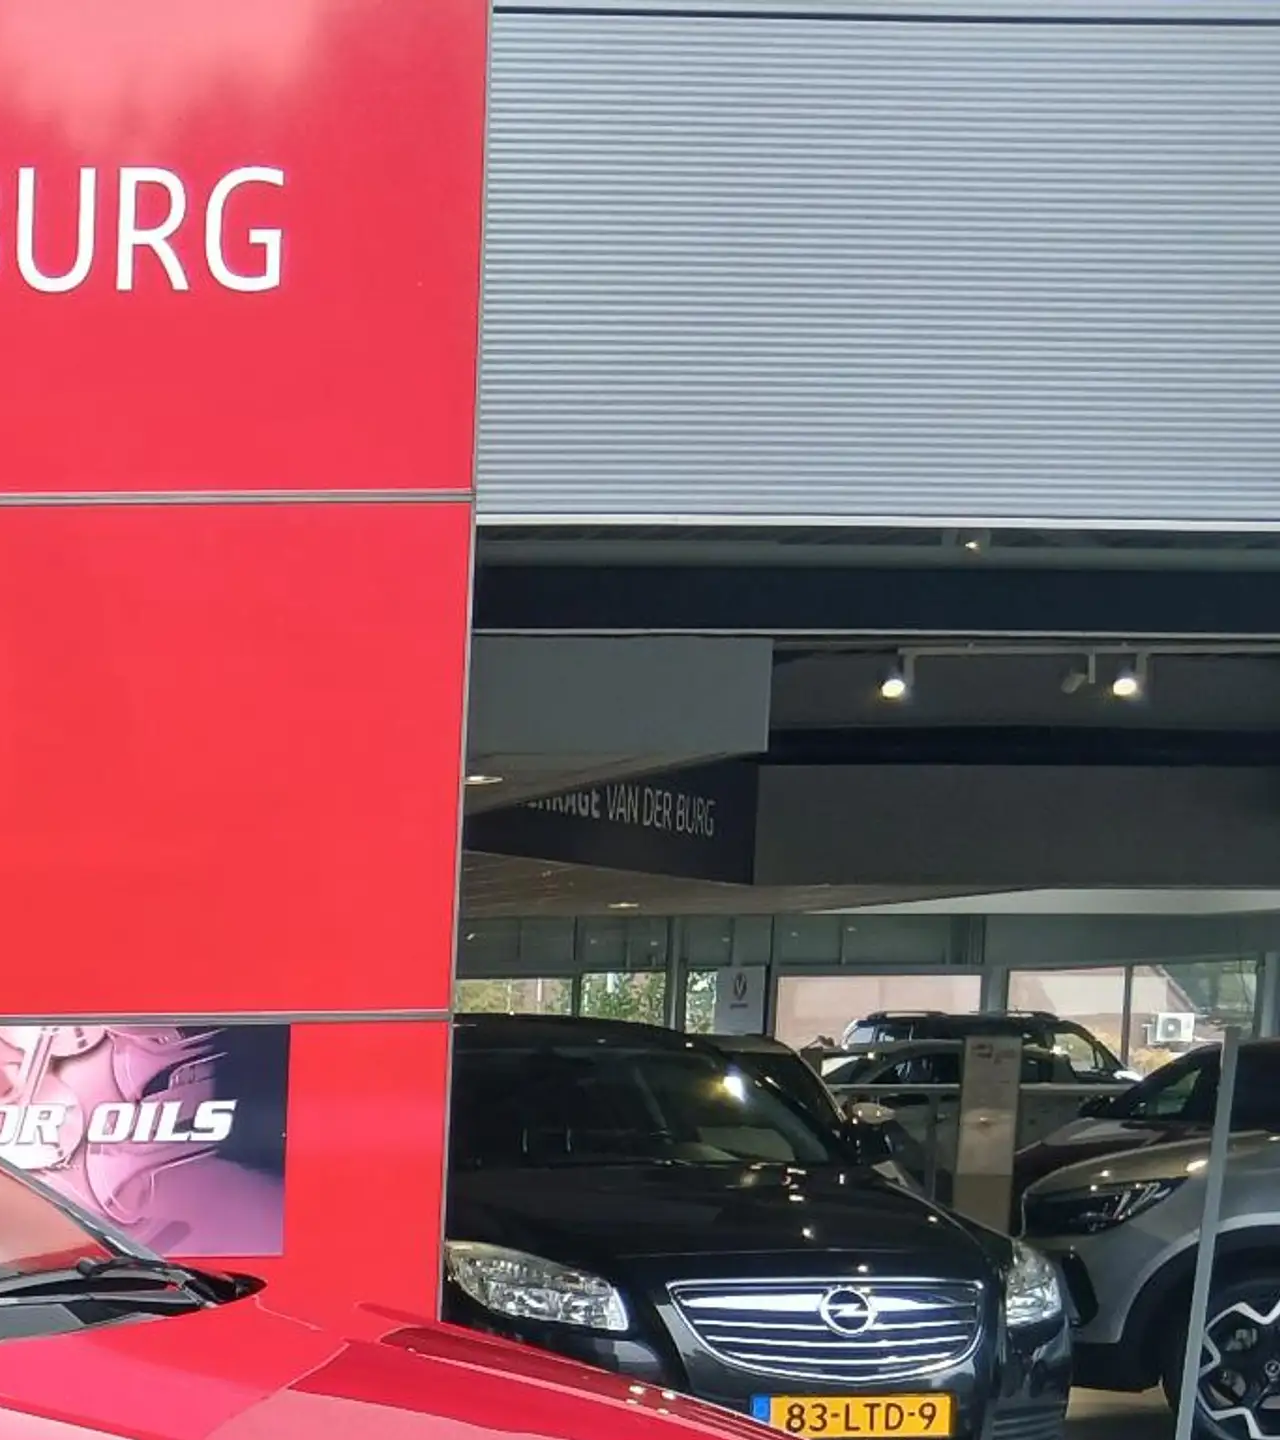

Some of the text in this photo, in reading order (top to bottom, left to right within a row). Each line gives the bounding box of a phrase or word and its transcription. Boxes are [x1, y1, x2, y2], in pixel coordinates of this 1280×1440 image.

[606, 784, 639, 824] VAN
[643, 787, 672, 831] DER
[676, 793, 716, 837] BURG
[87, 1099, 238, 1143] OILS
[785, 1402, 938, 1432] 83-LTD-9
